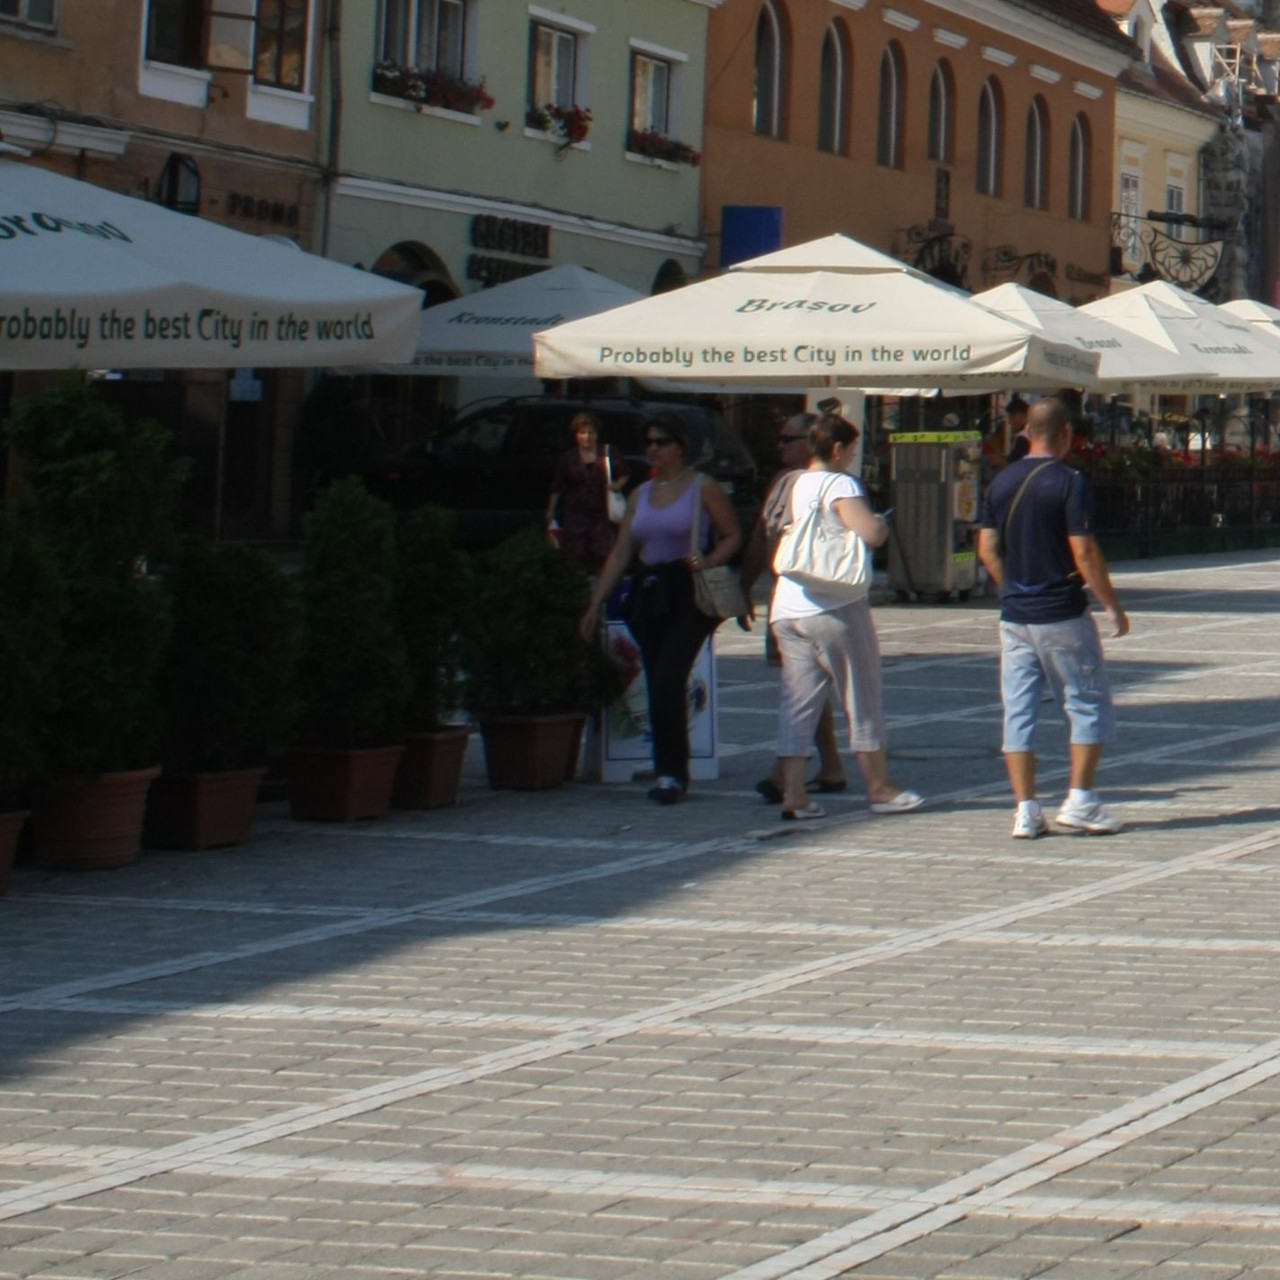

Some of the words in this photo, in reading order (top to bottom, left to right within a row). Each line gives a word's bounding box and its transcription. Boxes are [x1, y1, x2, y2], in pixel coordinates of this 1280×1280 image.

[735, 298, 877, 315] Brașov
[0, 307, 90, 349] robably
[100, 308, 136, 341] the
[144, 308, 192, 341] best
[197, 308, 242, 349] City
[251, 311, 268, 341] in
[276, 312, 309, 341] the
[316, 312, 375, 341] world
[599, 346, 694, 368] Probably
[702, 346, 735, 363] the
[743, 346, 787, 363] best
[794, 344, 836, 366] City
[845, 345, 863, 362] in
[871, 344, 905, 362] the
[912, 344, 972, 362] world
